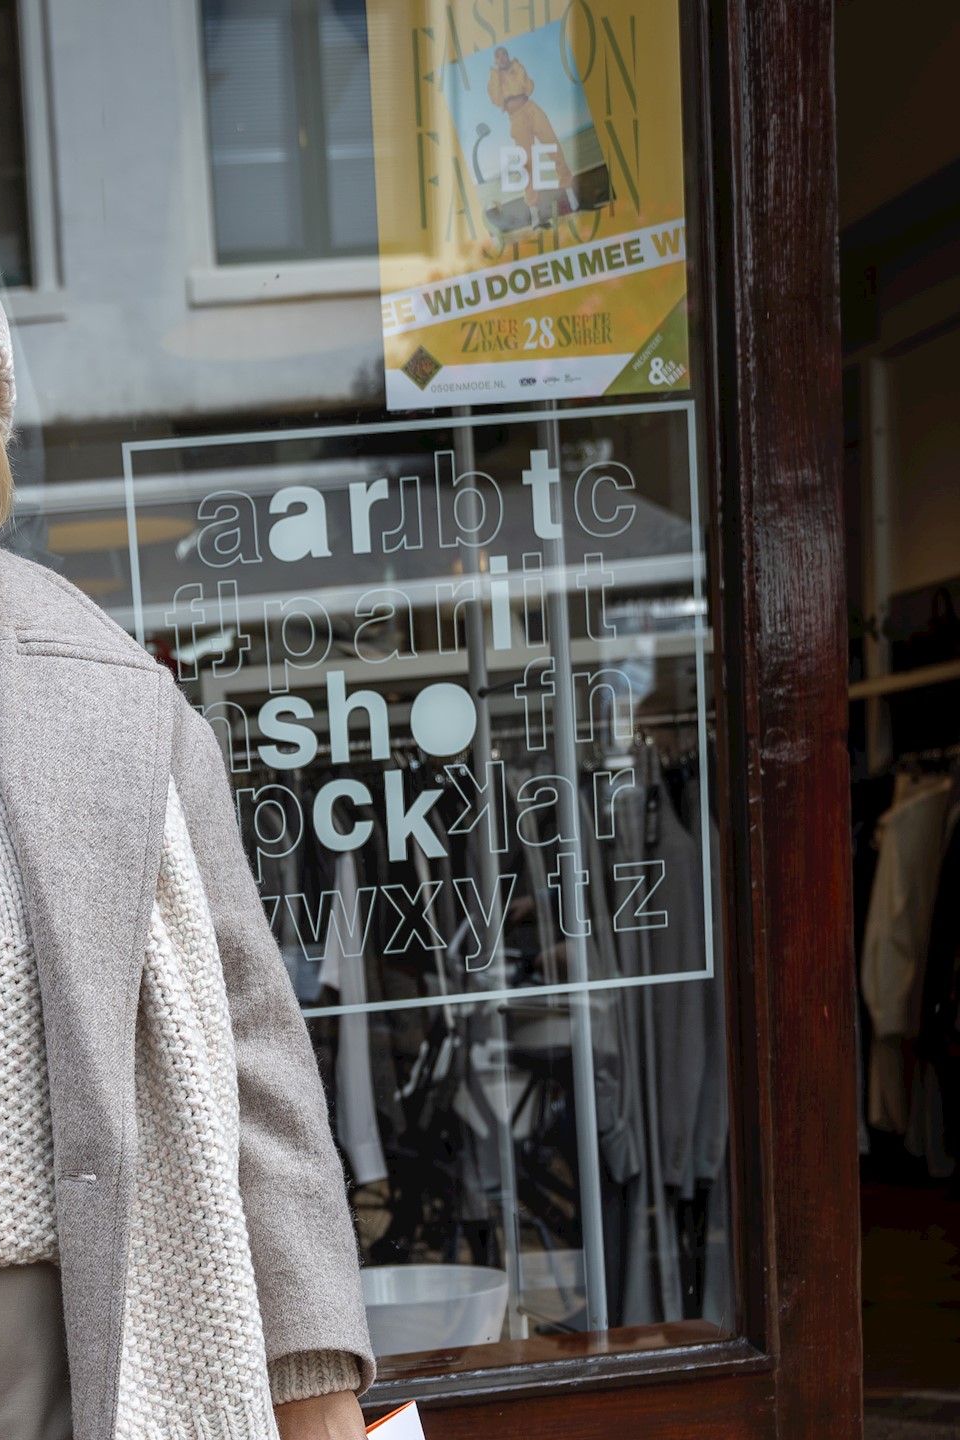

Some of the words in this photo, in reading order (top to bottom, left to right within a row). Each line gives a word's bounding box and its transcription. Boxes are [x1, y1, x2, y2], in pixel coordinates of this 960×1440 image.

[500, 138, 559, 192] BE
[422, 279, 481, 317] WIJ
[486, 257, 575, 302] DOEN
[577, 238, 644, 278] MEE
[651, 226, 686, 258] W
[523, 316, 555, 351] 28
